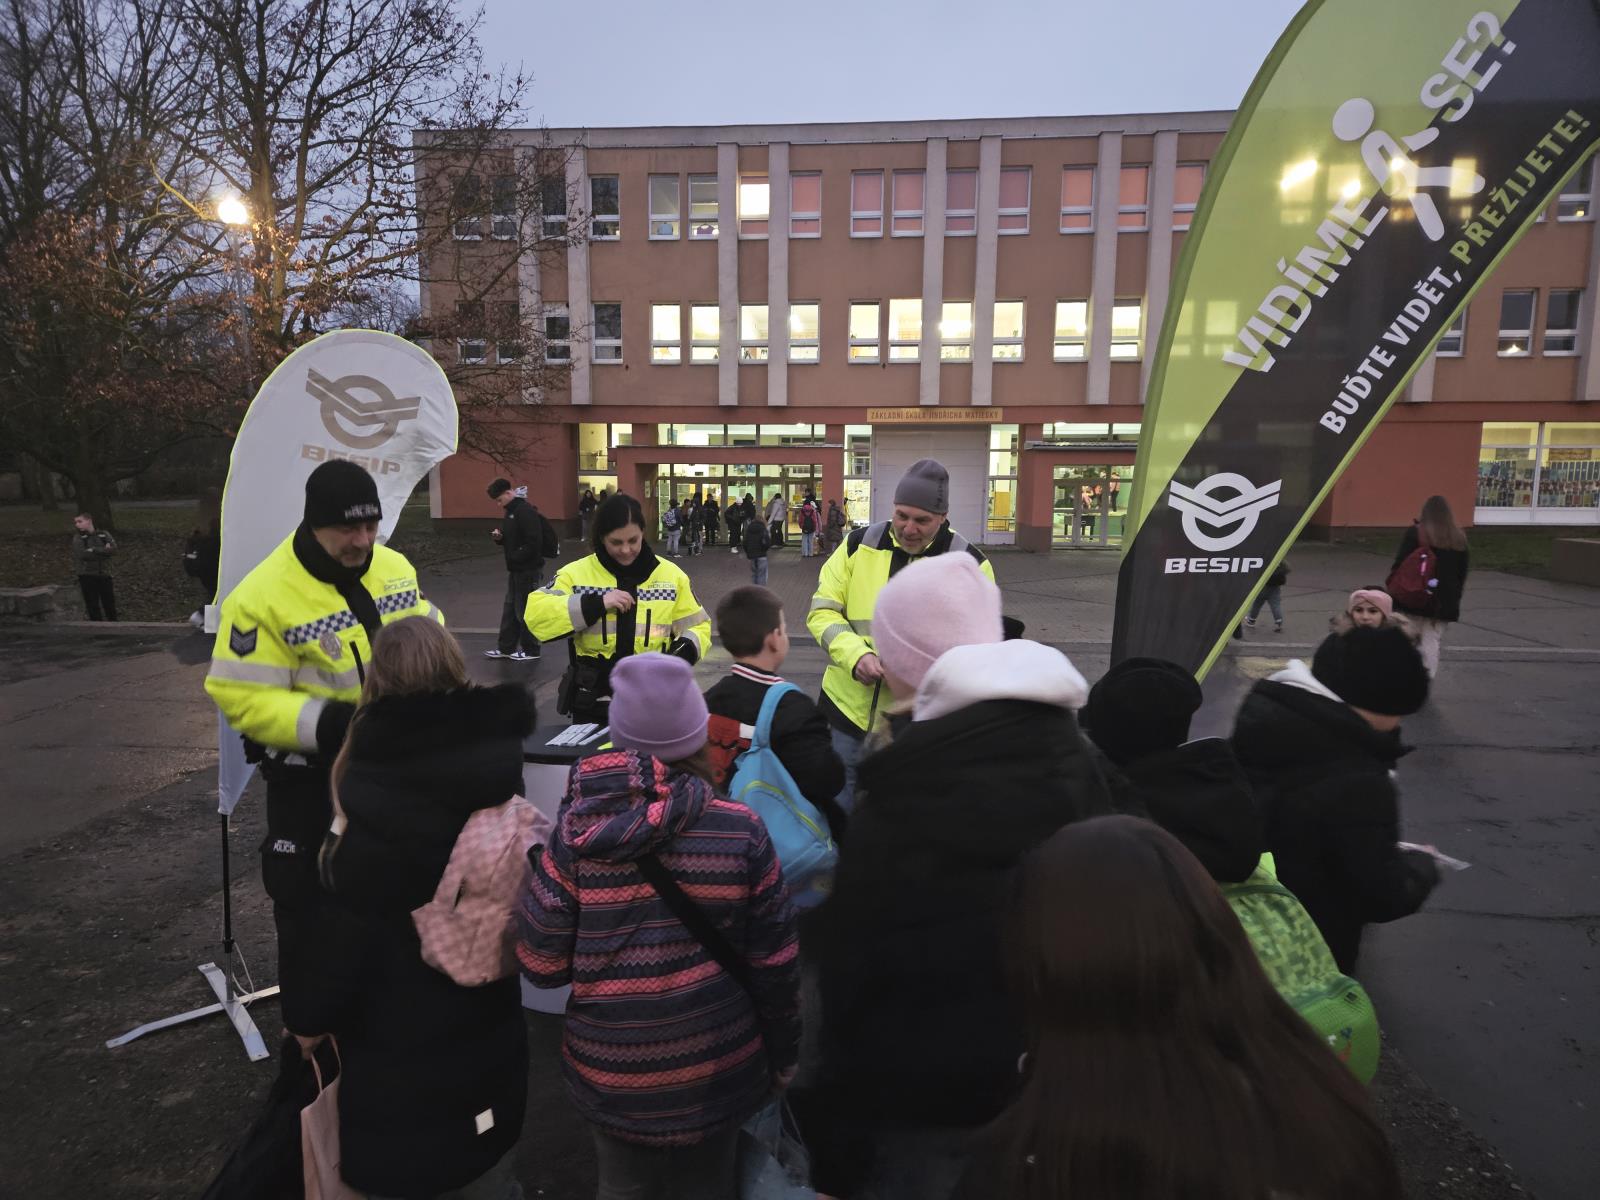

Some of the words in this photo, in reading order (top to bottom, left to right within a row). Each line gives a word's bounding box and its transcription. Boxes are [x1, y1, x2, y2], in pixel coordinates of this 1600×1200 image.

[1222, 195, 1389, 373] VIDÍME
[1420, 11, 1517, 122] SE?
[1319, 345, 1396, 434] BUĎTE
[1382, 266, 1462, 346] VIDĚT,
[1450, 109, 1591, 264] PŘEŽIJETE!
[1164, 557, 1264, 574] BESIP
